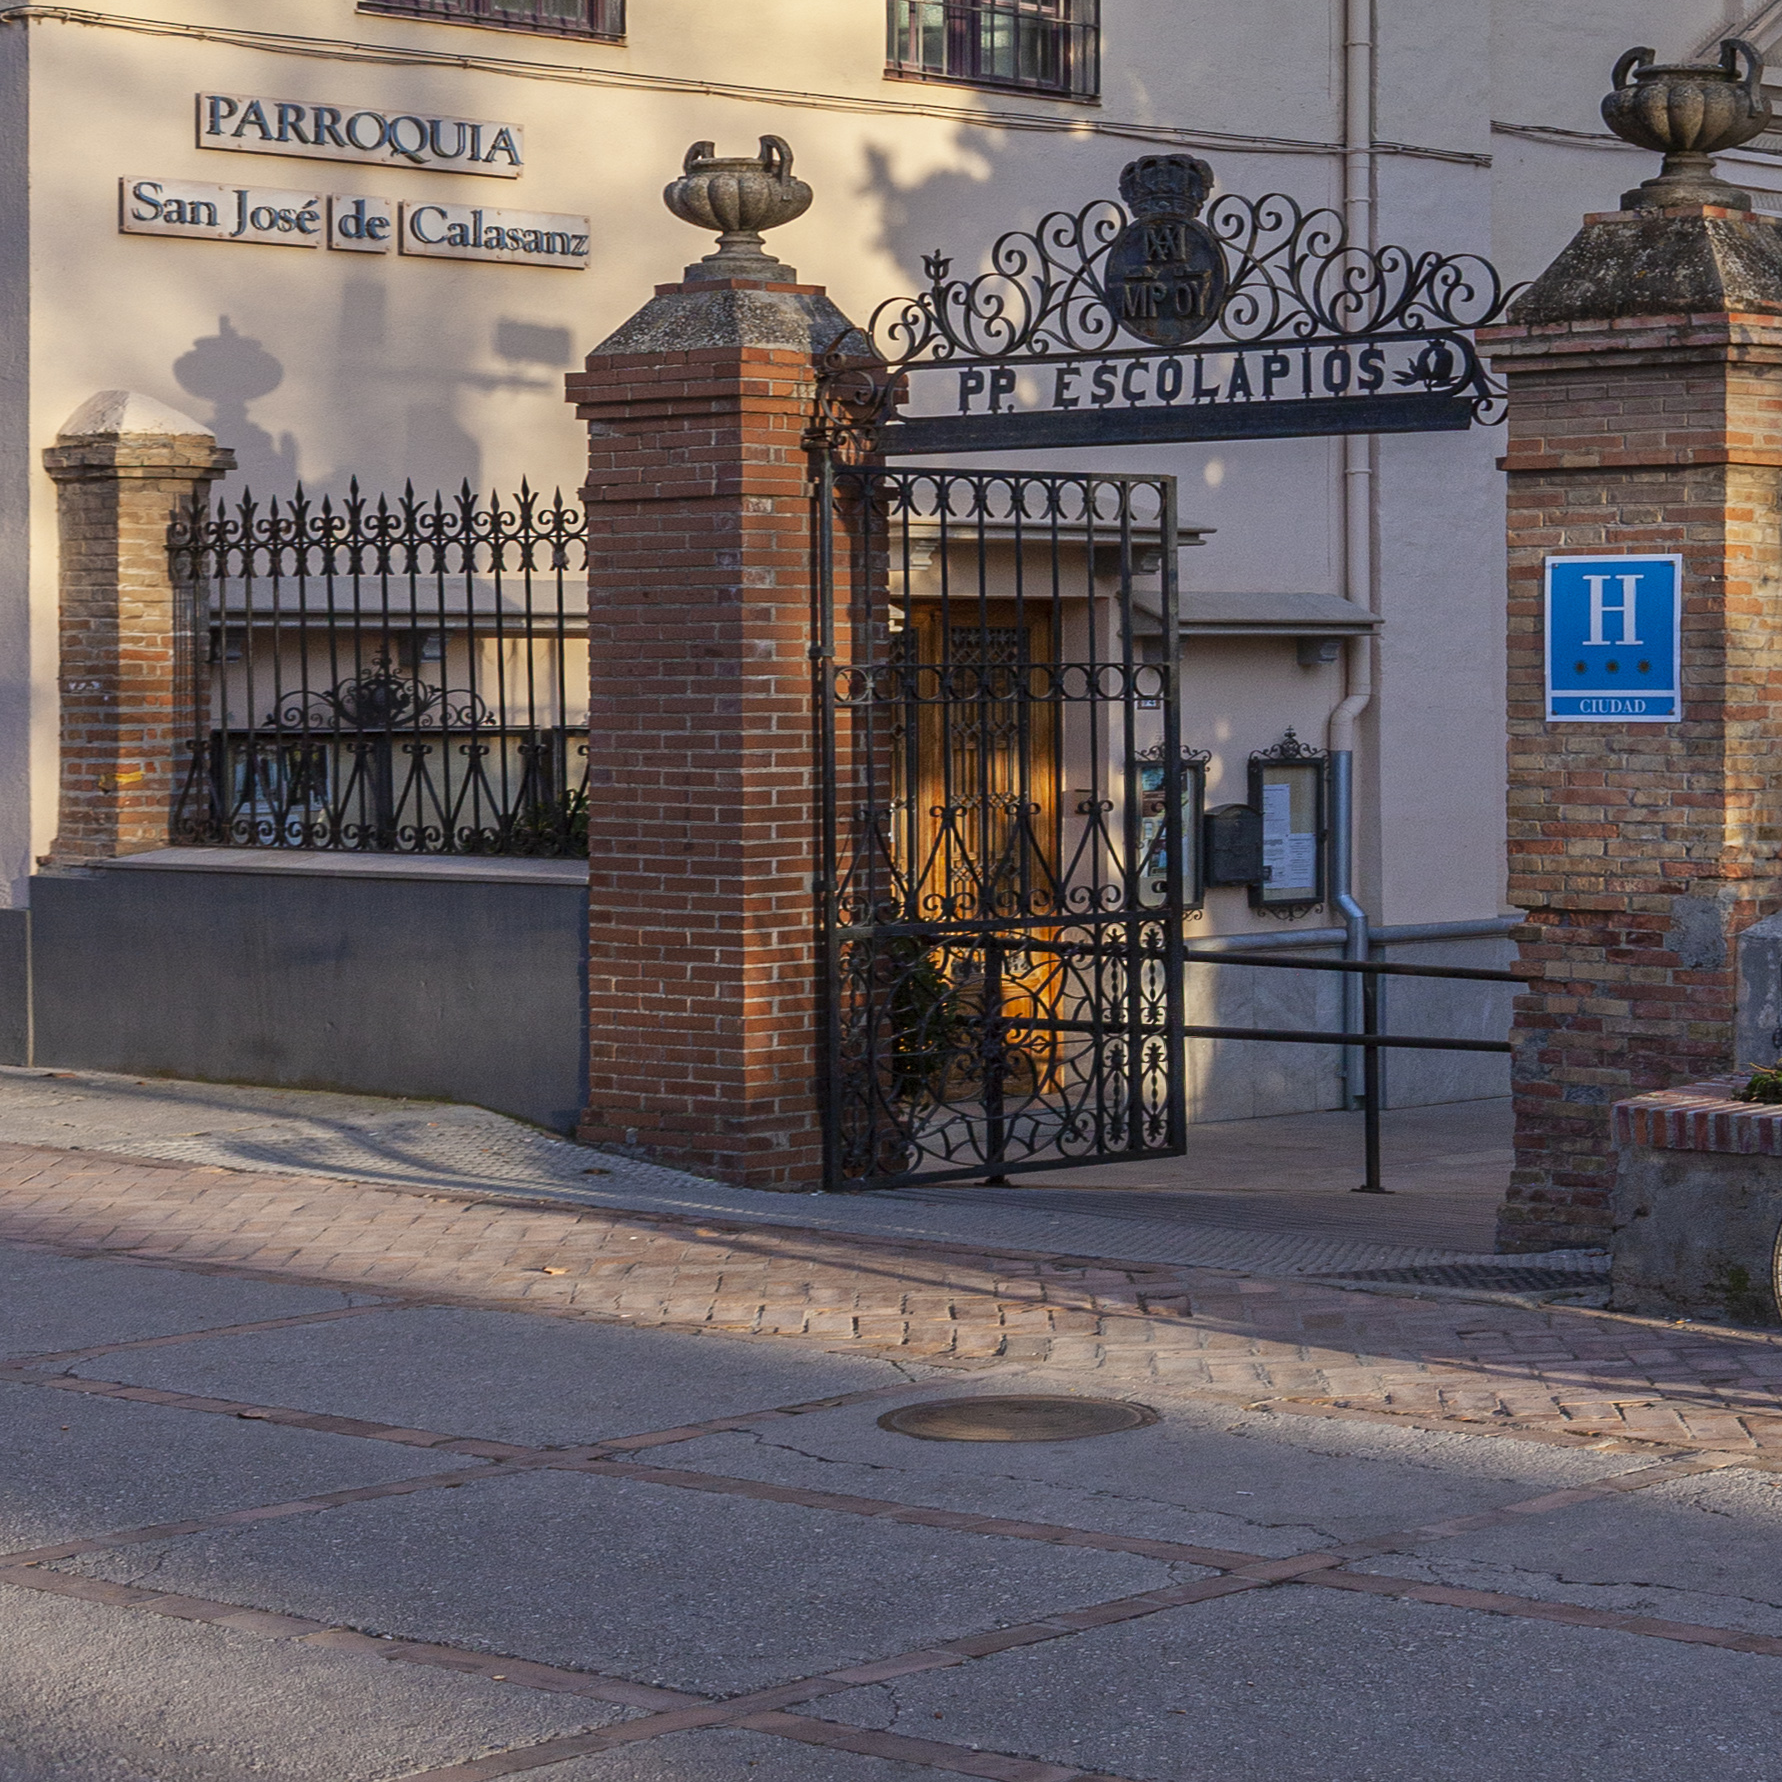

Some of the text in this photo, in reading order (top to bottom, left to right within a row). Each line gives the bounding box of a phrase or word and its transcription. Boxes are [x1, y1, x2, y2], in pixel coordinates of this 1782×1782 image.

[204, 94, 525, 166] PARROQUIA
[131, 181, 589, 257] San José de Calasanz
[1053, 346, 1387, 409] ESCOLAPIOS
[1582, 574, 1645, 646] H
[1579, 698, 1647, 714] CIUDAD
